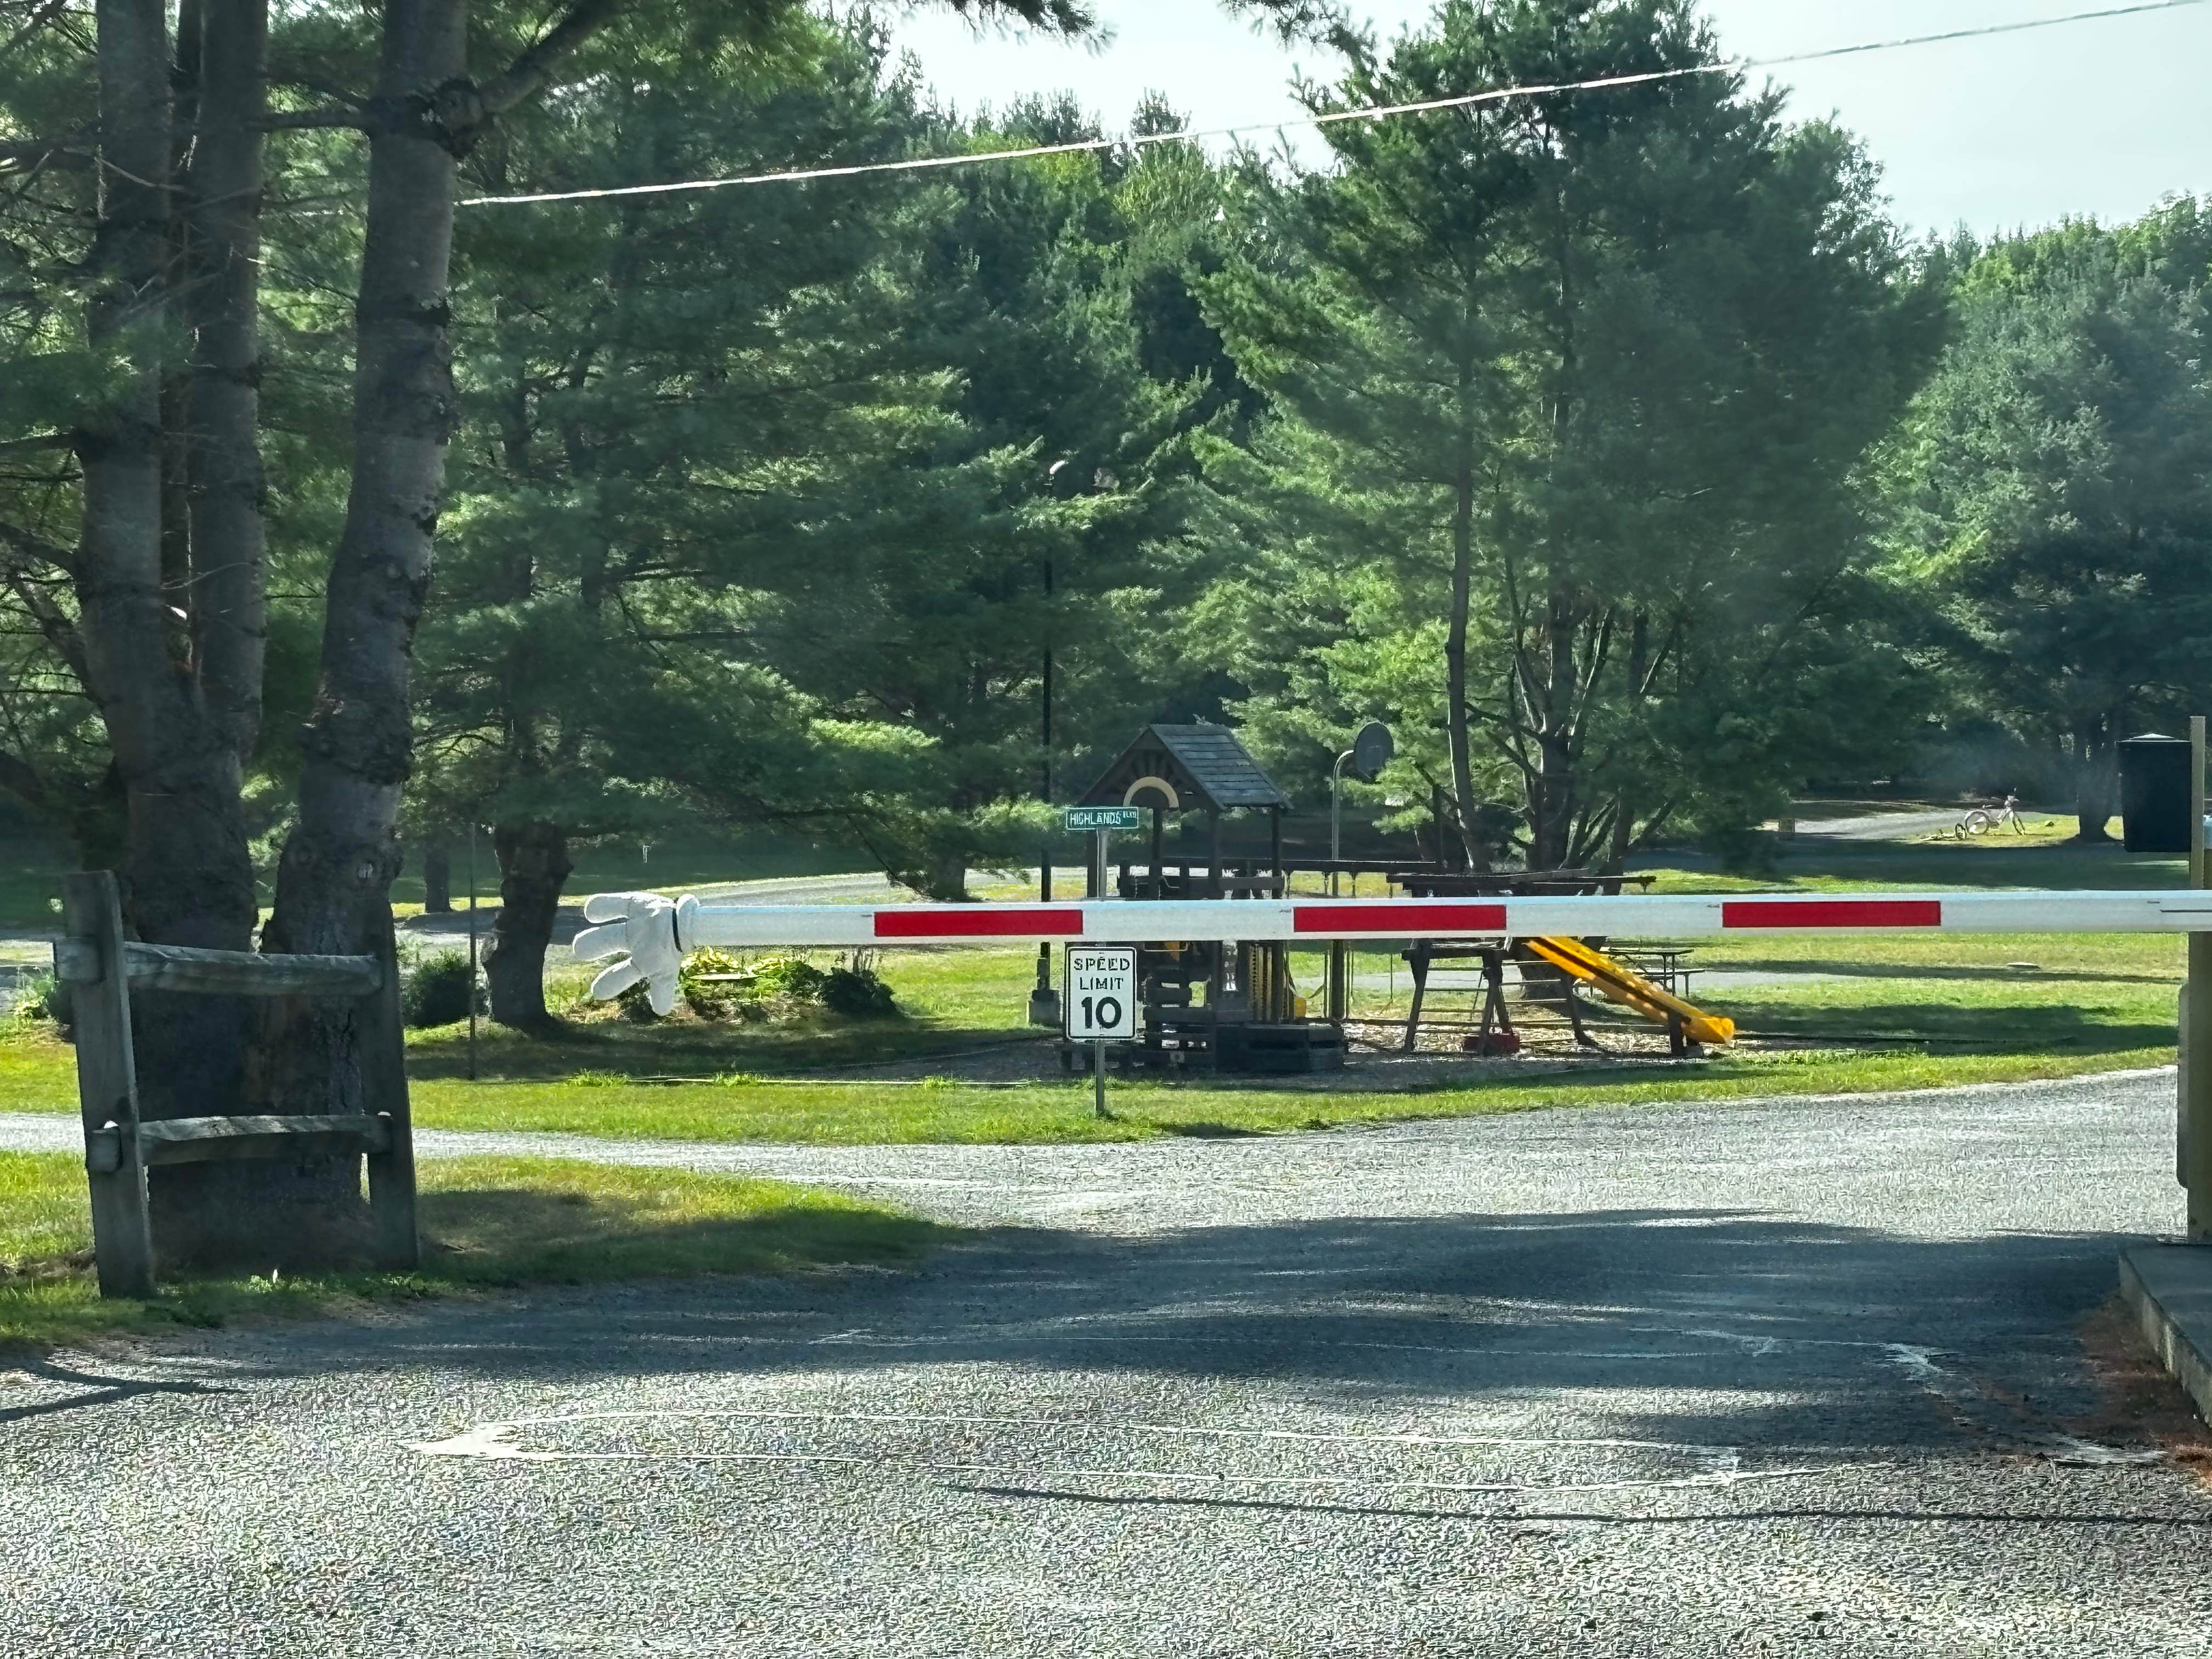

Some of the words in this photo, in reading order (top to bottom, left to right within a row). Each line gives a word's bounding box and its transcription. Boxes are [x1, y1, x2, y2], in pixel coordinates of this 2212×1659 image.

[1070, 811, 1121, 826] HIGHLANDS
[1074, 958, 1130, 971] SPEED
[1080, 977, 1124, 990] LIMIT
[1081, 997, 1122, 1029] 10
